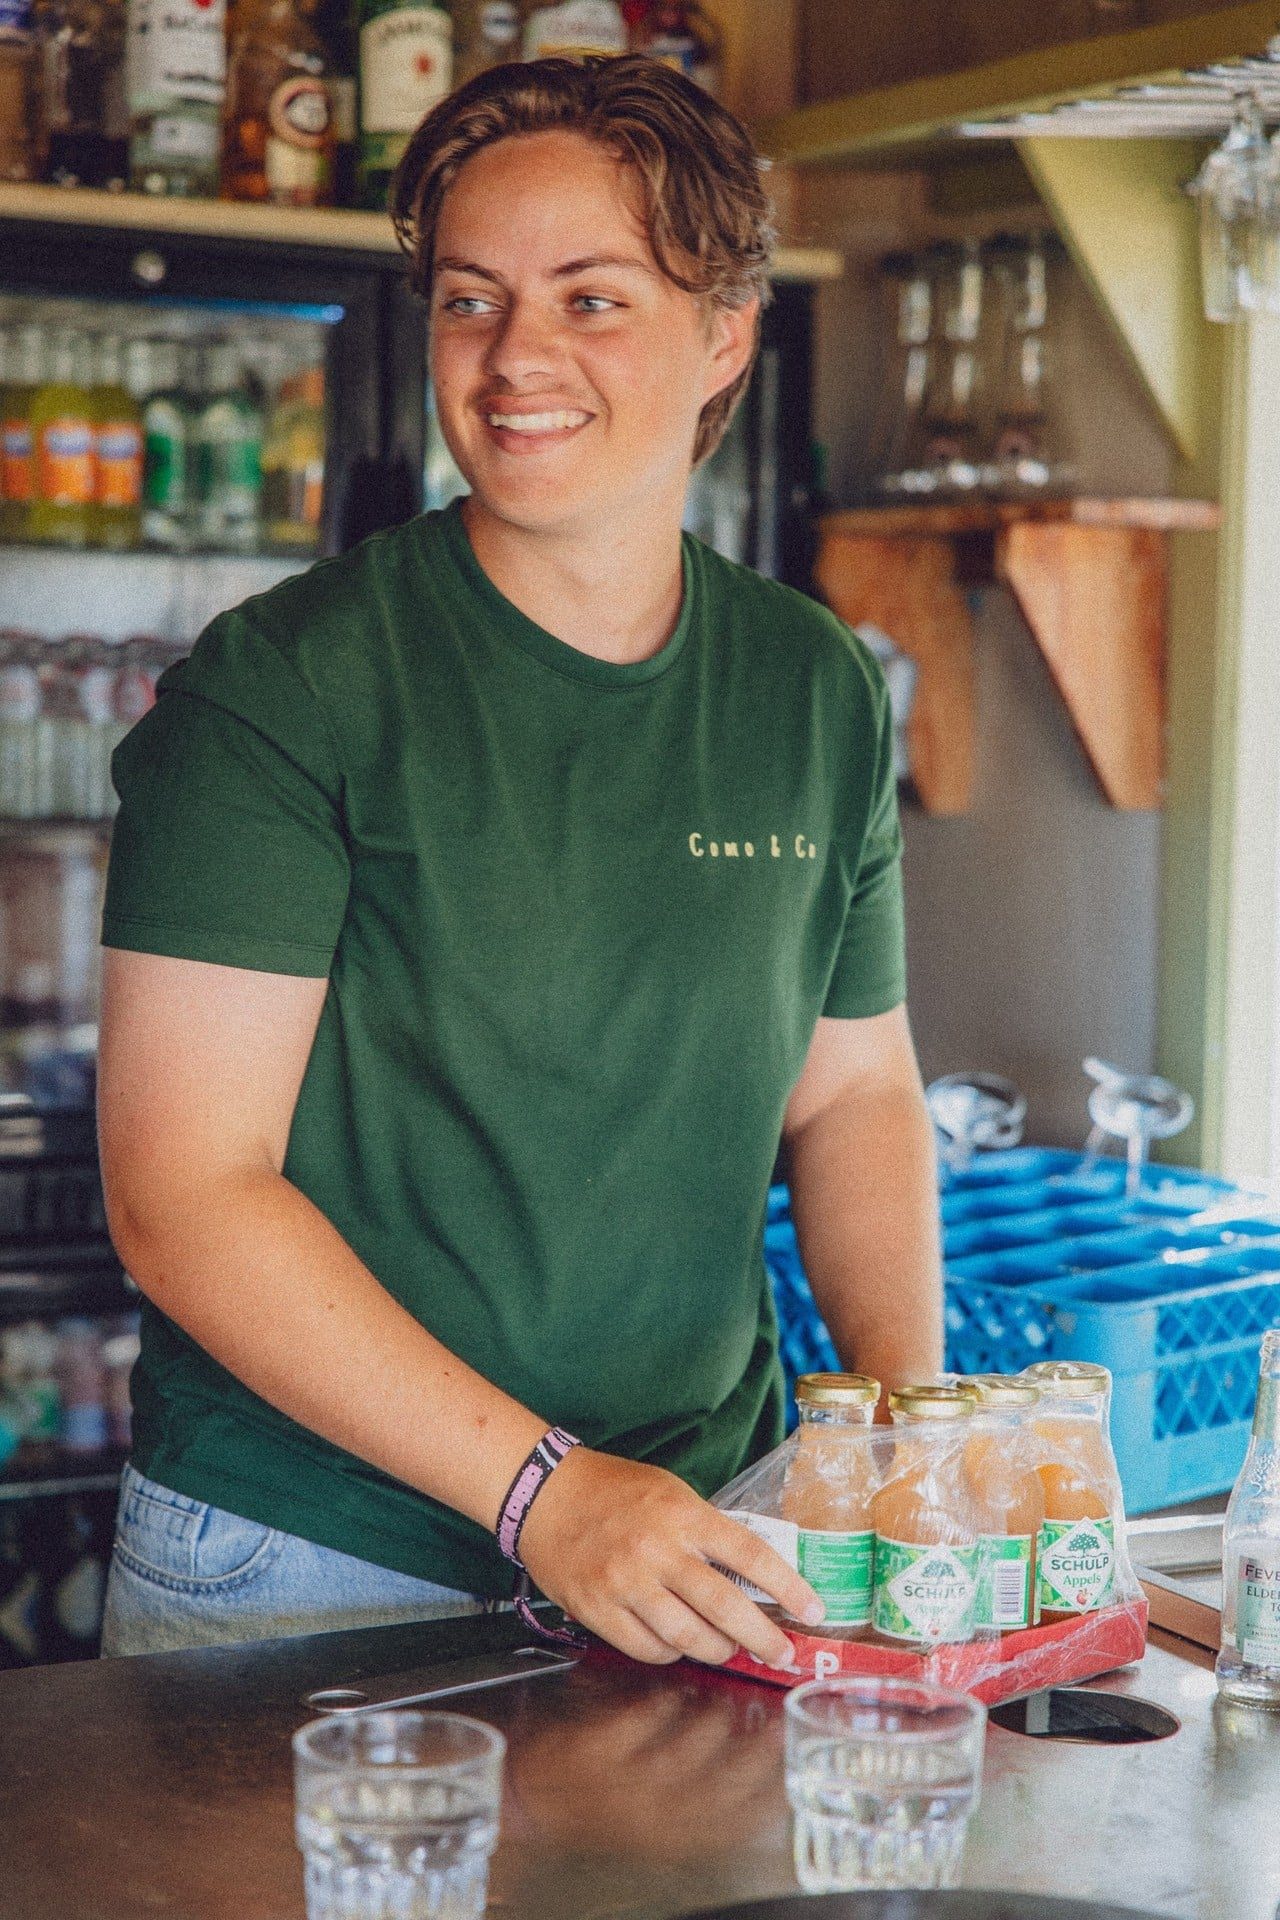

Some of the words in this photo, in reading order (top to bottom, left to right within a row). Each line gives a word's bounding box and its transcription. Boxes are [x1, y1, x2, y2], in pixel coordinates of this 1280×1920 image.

[689, 832, 755, 857] Como
[795, 834, 816, 859] Co
[1051, 1556, 1109, 1571] SCHULP
[1063, 1573, 1101, 1588] Appels
